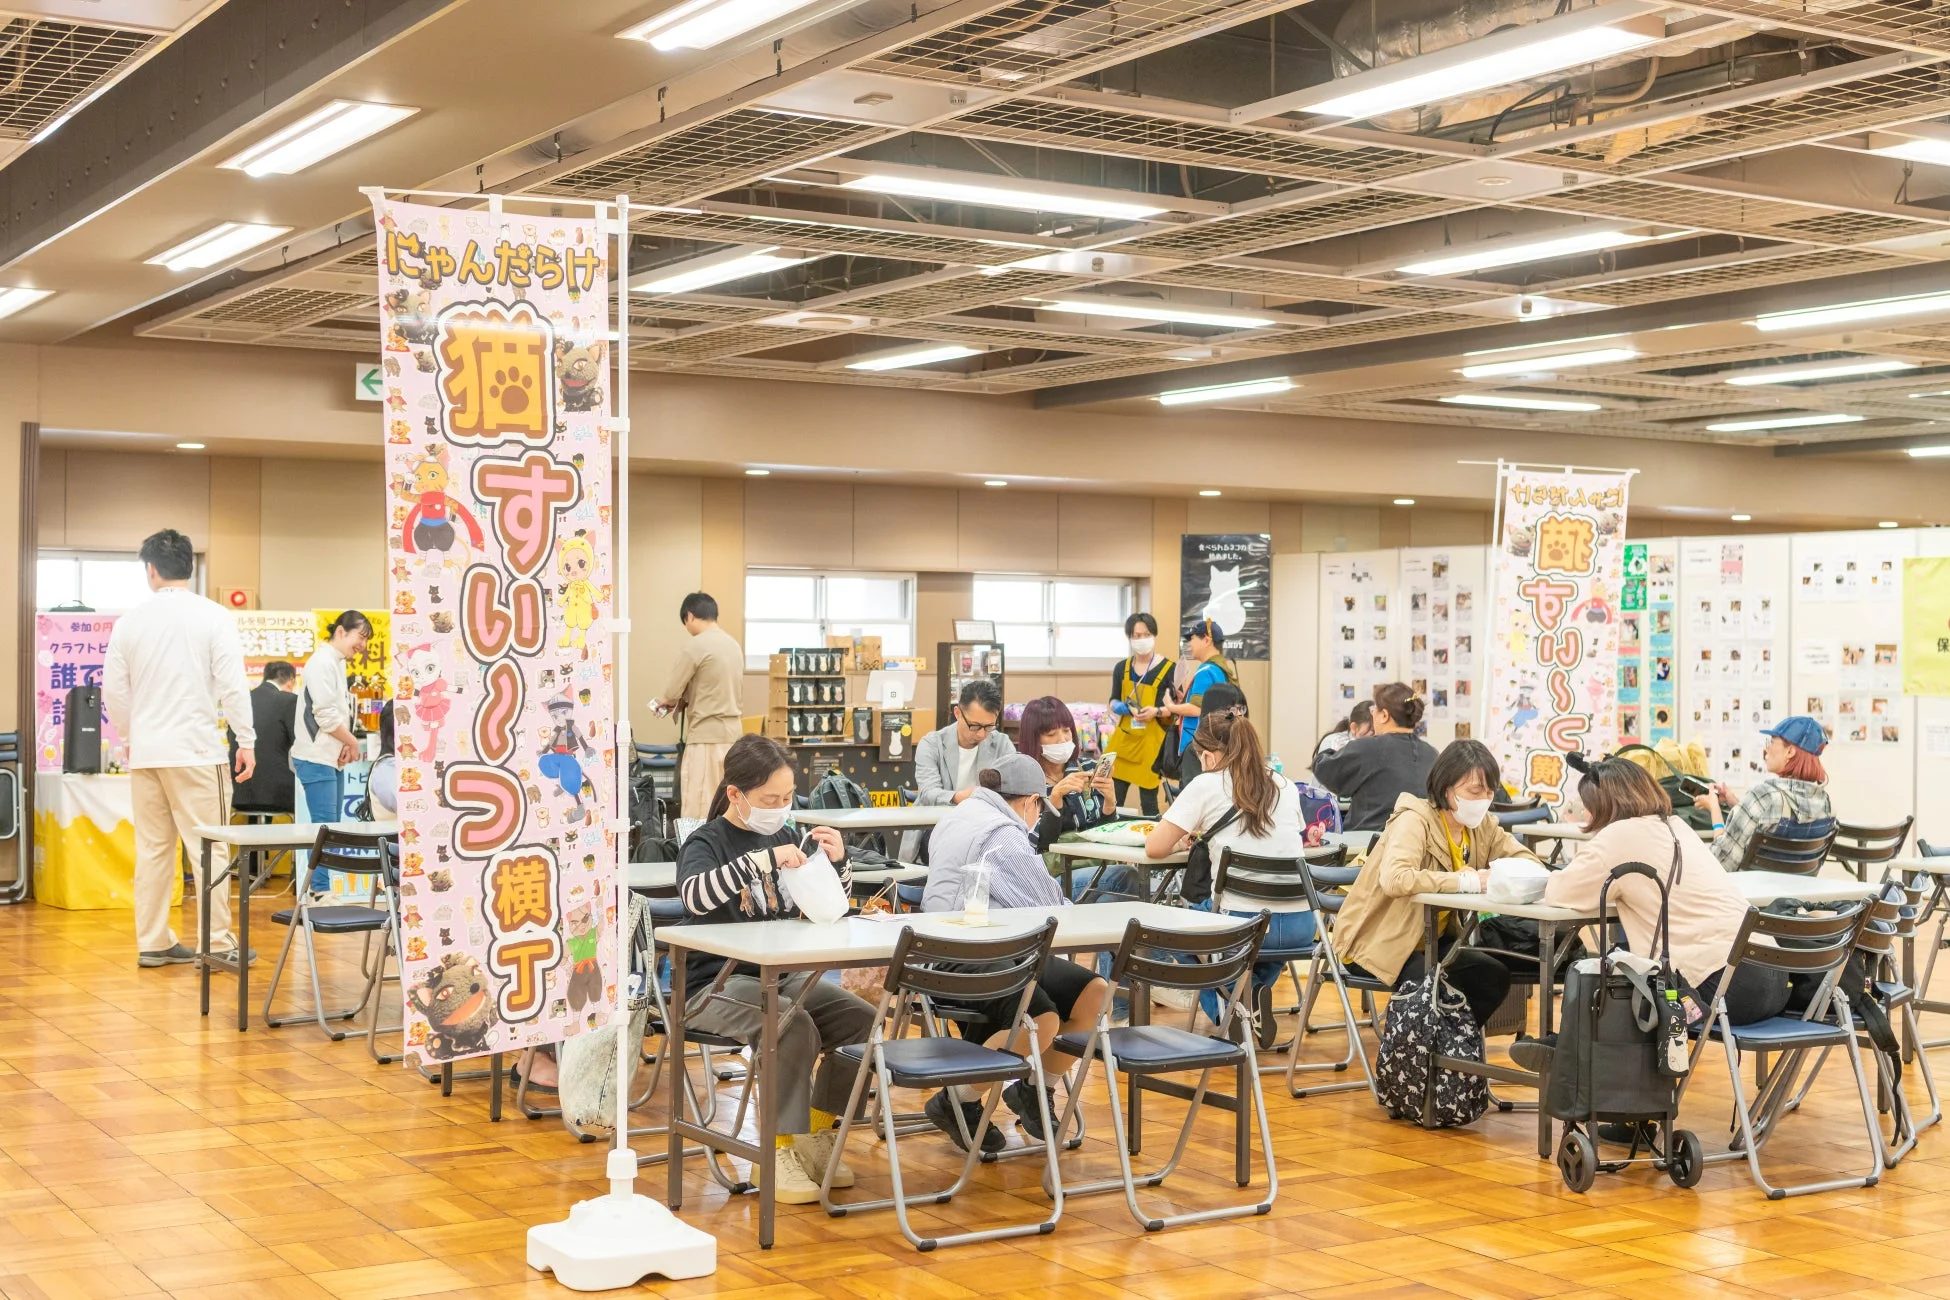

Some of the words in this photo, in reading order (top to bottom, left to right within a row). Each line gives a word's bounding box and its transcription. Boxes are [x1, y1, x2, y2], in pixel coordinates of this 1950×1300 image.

[386, 232, 600, 290] にゃんだらけ
